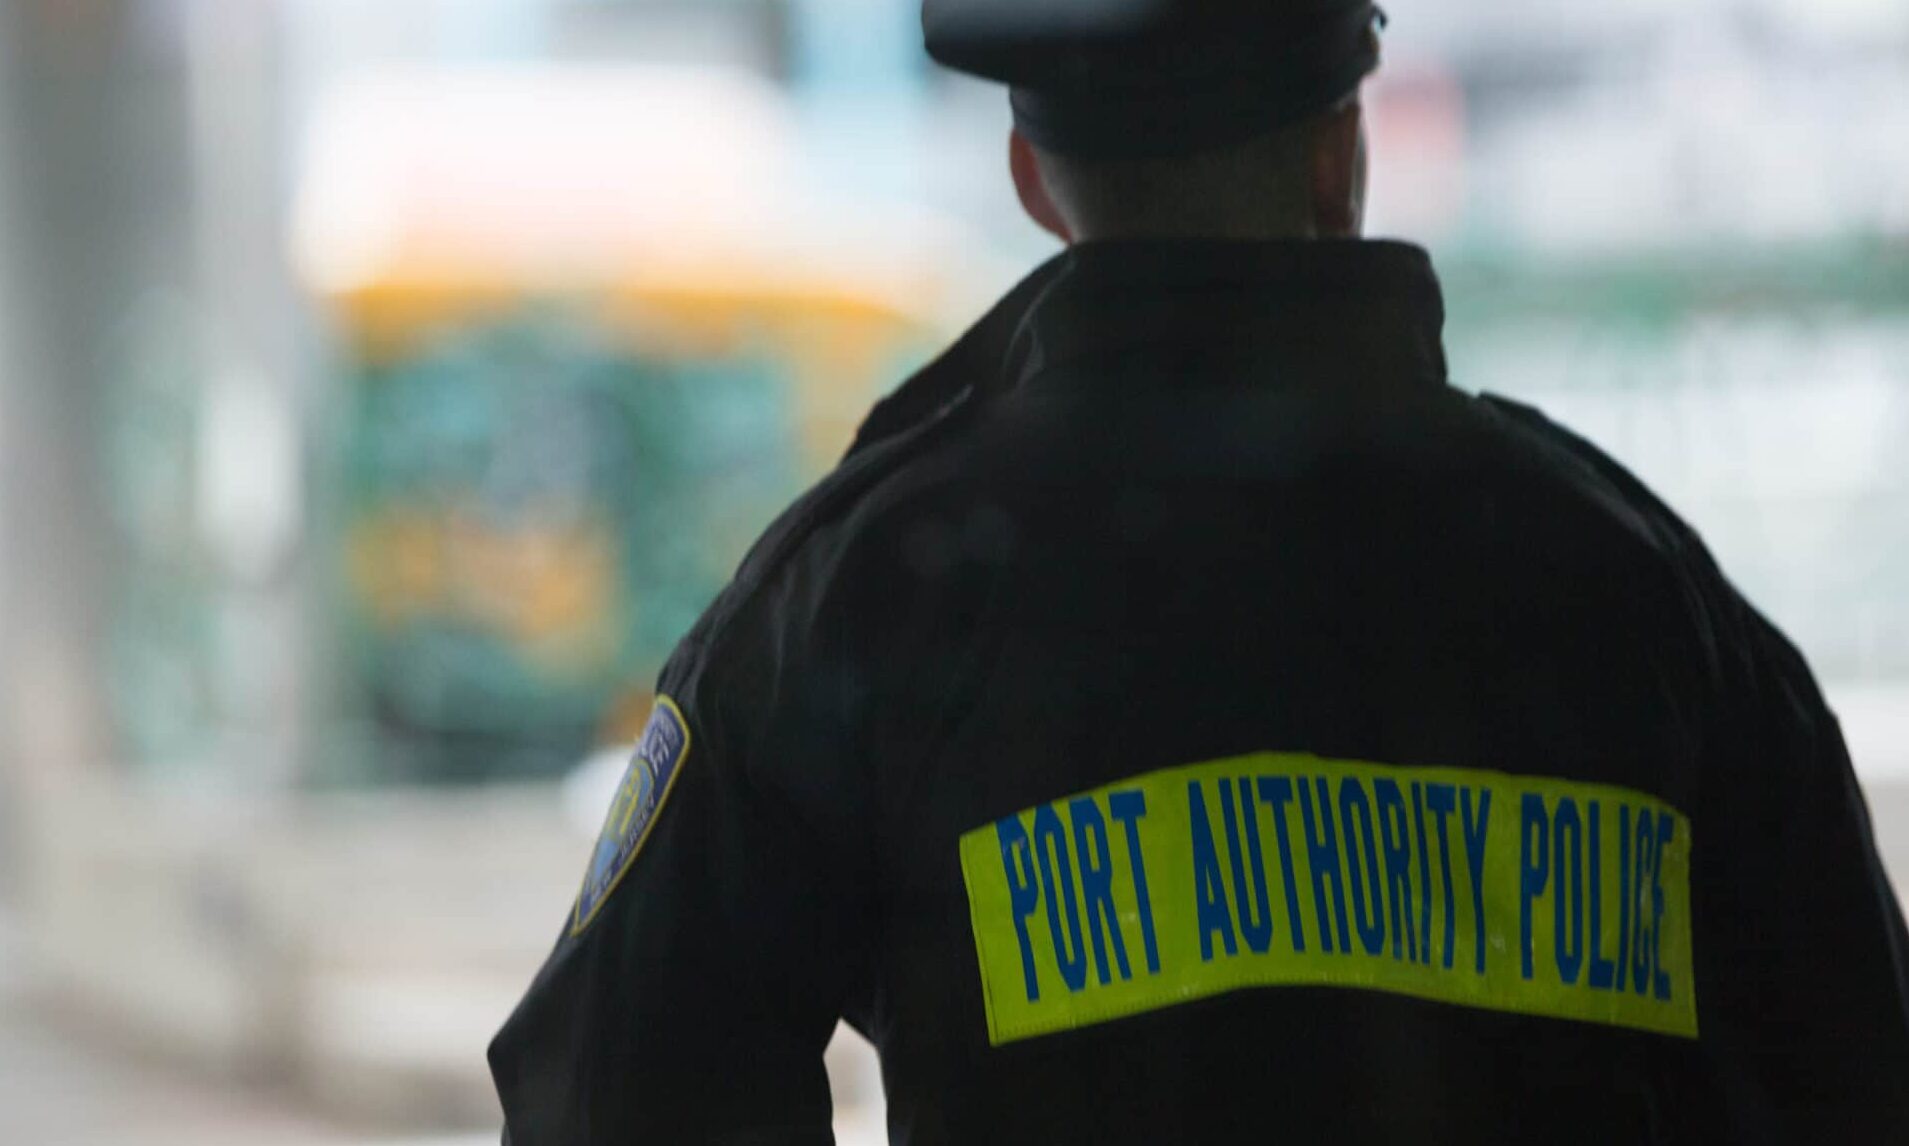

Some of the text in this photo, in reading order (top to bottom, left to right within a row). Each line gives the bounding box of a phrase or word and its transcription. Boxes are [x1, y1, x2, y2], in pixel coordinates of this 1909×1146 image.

[996, 776, 1674, 1003] PORT AUTHORITY POLICE
